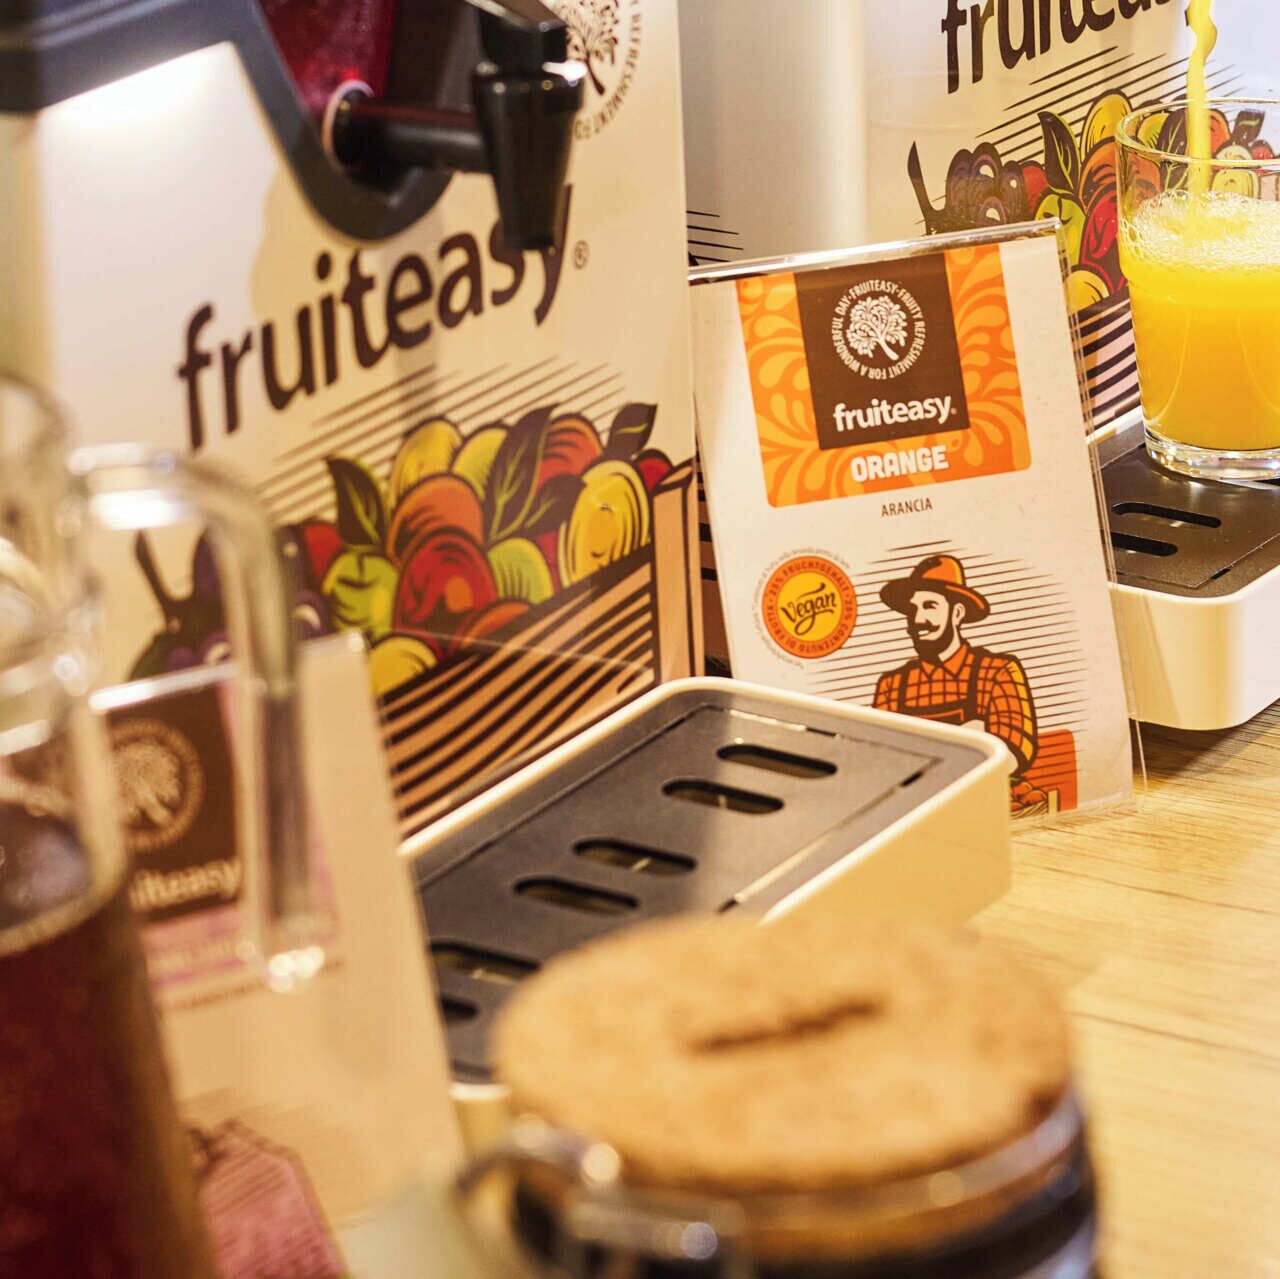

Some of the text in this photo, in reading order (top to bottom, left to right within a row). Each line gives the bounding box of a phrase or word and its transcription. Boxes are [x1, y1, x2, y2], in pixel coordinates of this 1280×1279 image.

[835, 295, 852, 316] DAY
[849, 279, 899, 300] FRUITEASY
[897, 289, 924, 319] FRUITY
[832, 317, 862, 375] WONDERFUL
[889, 320, 926, 379] REFRESHMENT
[869, 367, 888, 380] FOR
[833, 395, 952, 432] fruiteasy
[851, 445, 949, 482] ORANGE
[881, 497, 933, 518] ARANCIA
[780, 582, 837, 636] Vegan
